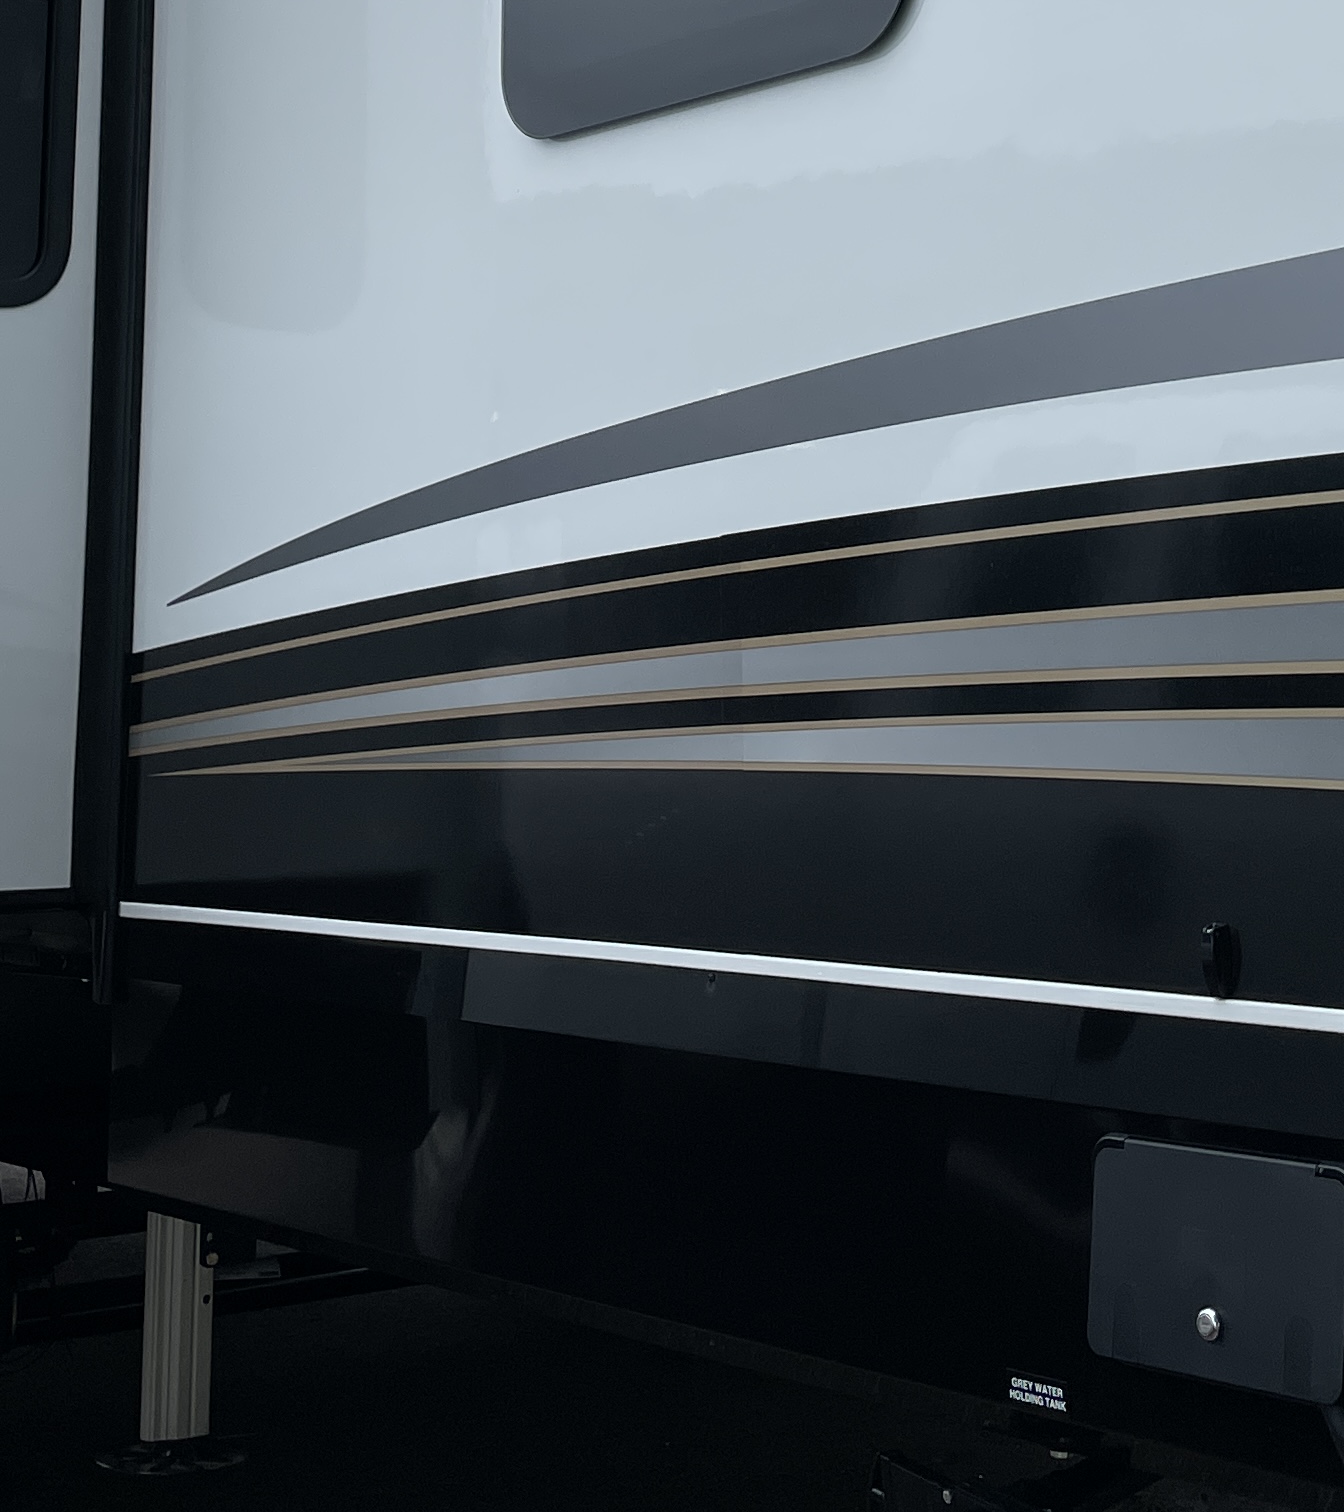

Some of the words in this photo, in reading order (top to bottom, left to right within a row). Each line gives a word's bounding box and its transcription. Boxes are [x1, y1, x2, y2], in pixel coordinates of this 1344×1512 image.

[1011, 1377, 1033, 1391] GREY
[1034, 1383, 1063, 1398] WATER
[1009, 1389, 1044, 1406] HOLDING
[1044, 1397, 1067, 1412] TANK
